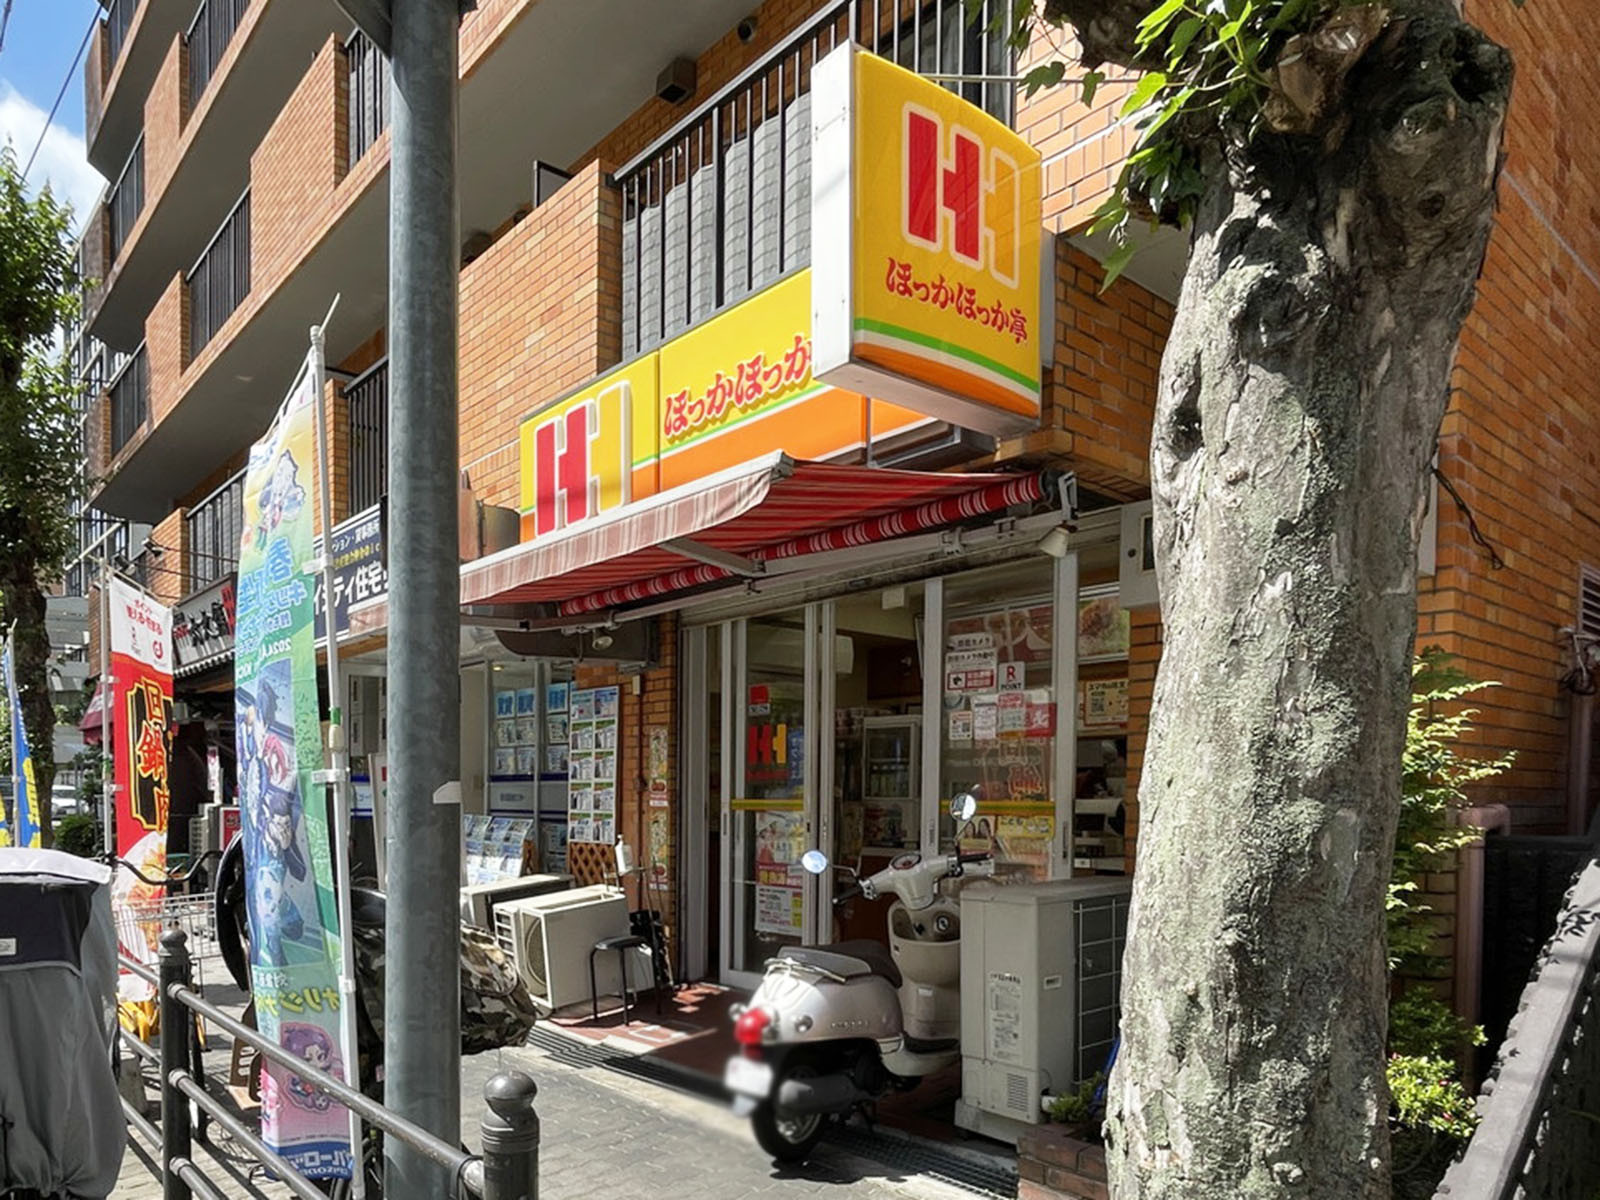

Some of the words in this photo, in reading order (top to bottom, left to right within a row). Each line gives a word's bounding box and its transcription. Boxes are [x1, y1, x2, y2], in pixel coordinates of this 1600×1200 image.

[885, 256, 1027, 344] ほっかほっか亭
[1006, 665, 1016, 680] R
[1001, 682, 1022, 690] POINT
